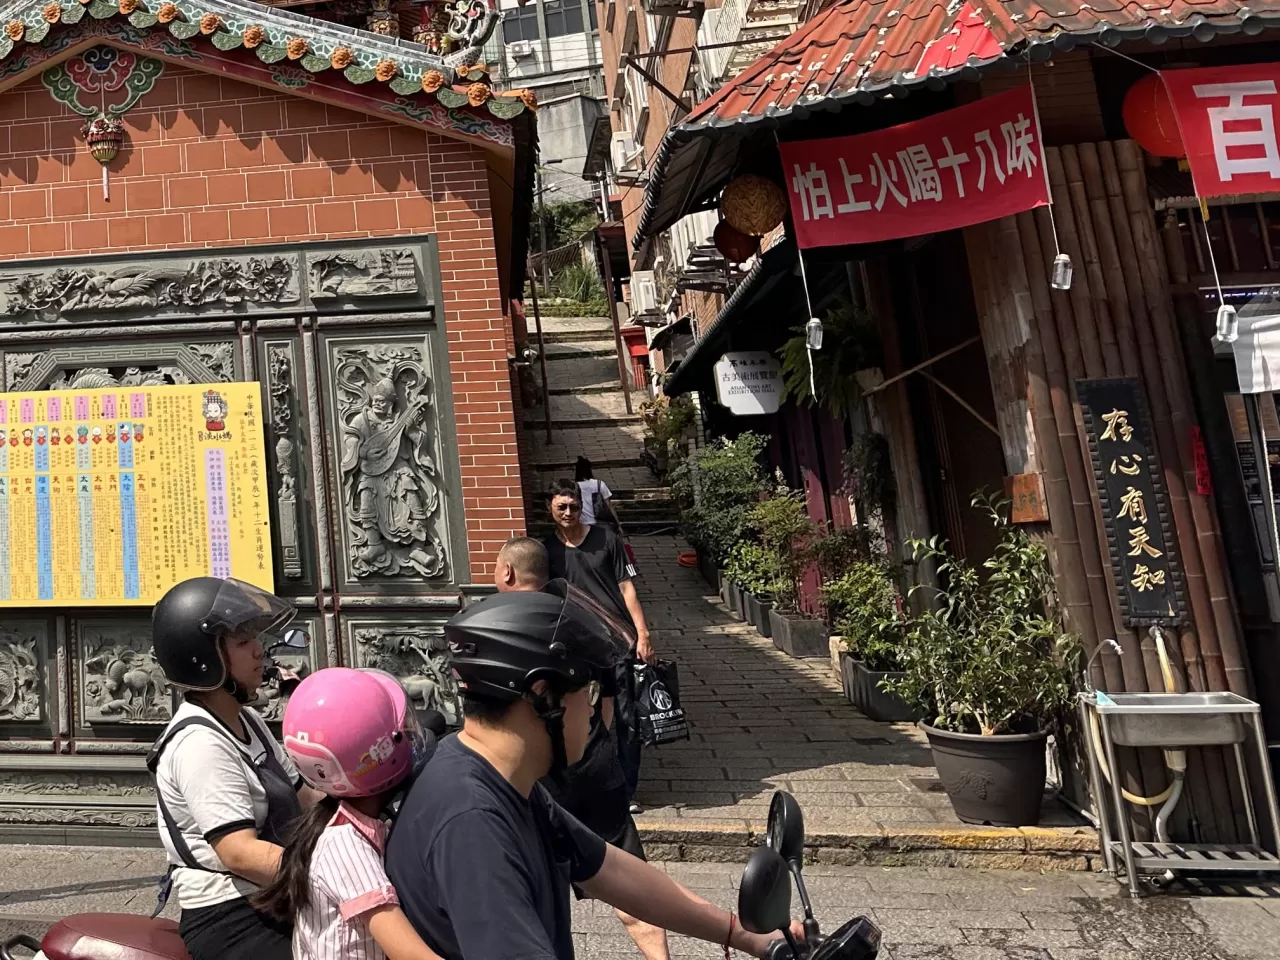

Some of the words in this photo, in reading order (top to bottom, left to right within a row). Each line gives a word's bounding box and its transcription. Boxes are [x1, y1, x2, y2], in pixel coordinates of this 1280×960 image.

[793, 113, 1037, 221] 怕上火喝十八味
[1192, 80, 1280, 181] 百
[1100, 408, 1165, 592] 存心有天知
